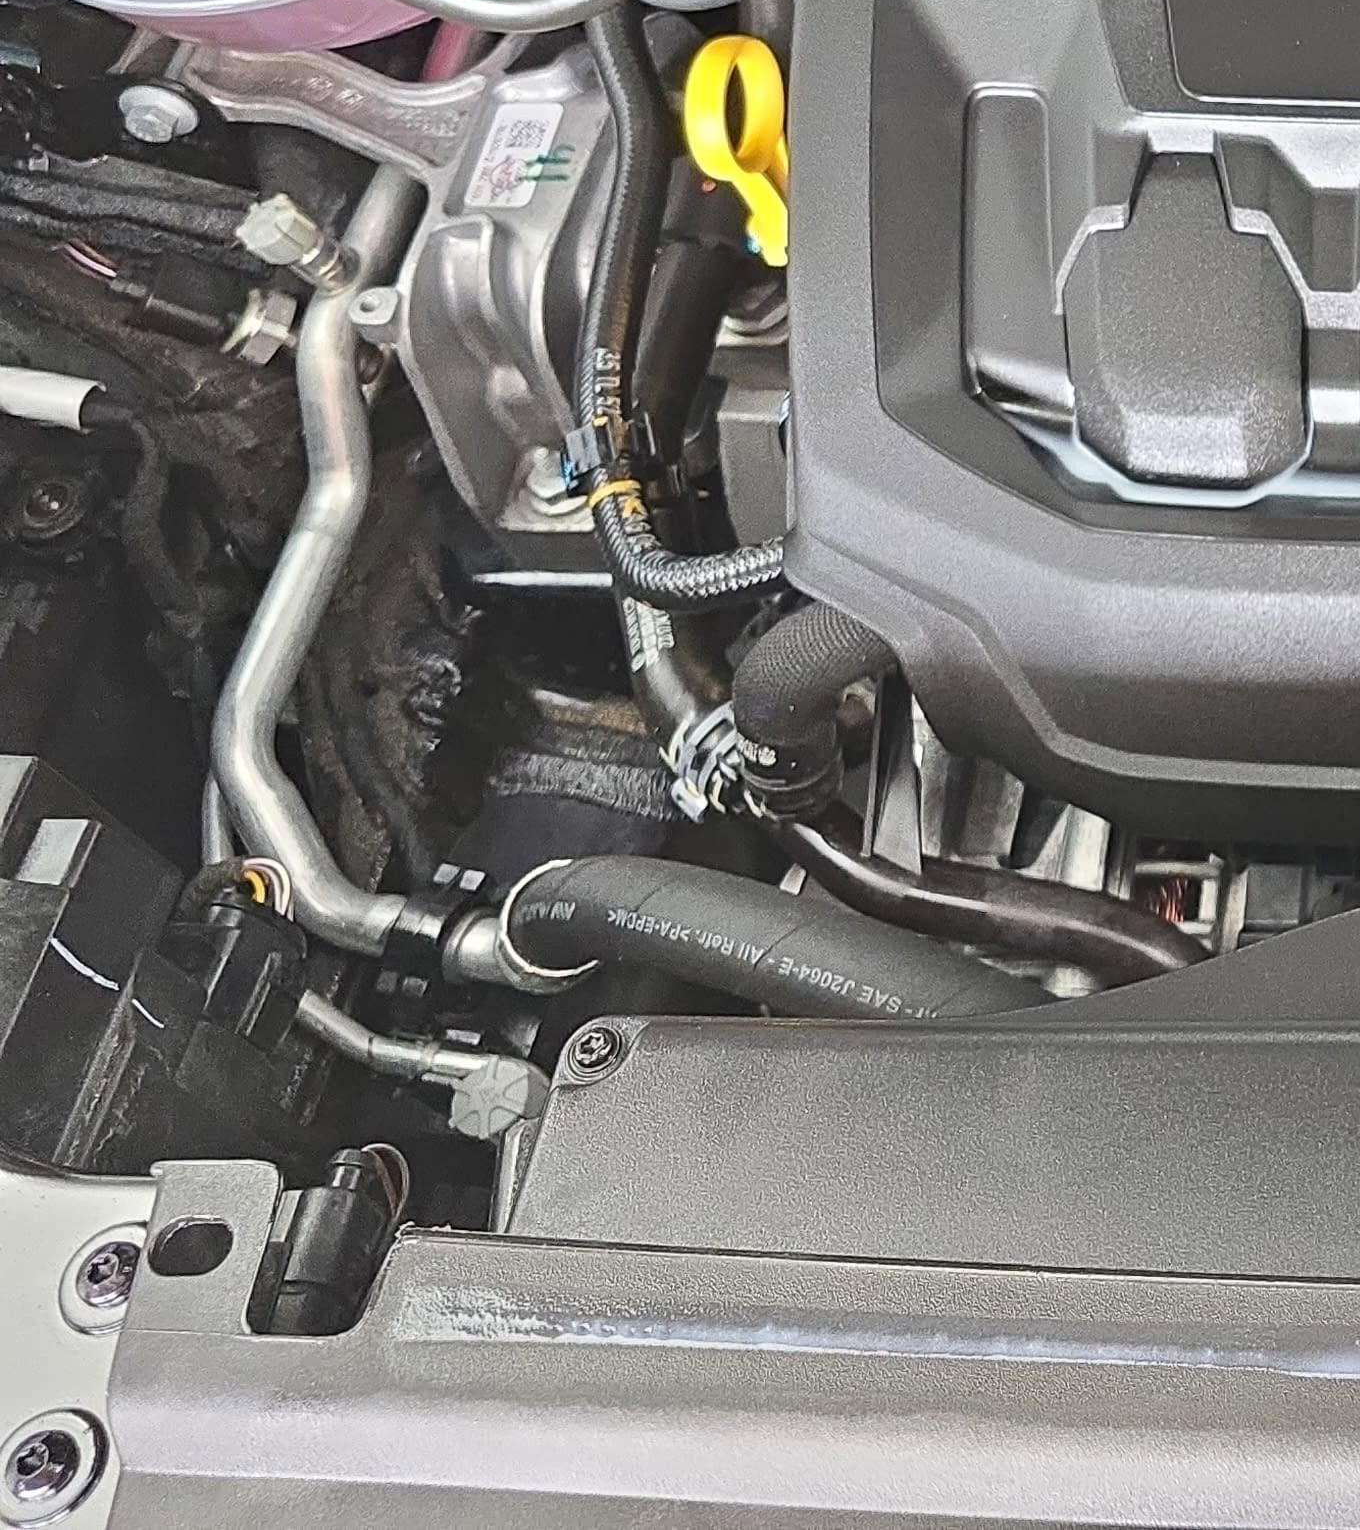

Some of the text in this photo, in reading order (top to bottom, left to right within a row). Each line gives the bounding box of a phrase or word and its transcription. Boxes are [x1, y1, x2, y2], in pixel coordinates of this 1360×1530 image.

[739, 942, 763, 966] All
[778, 956, 857, 992] J2064-E
[860, 984, 902, 1015] SAE
